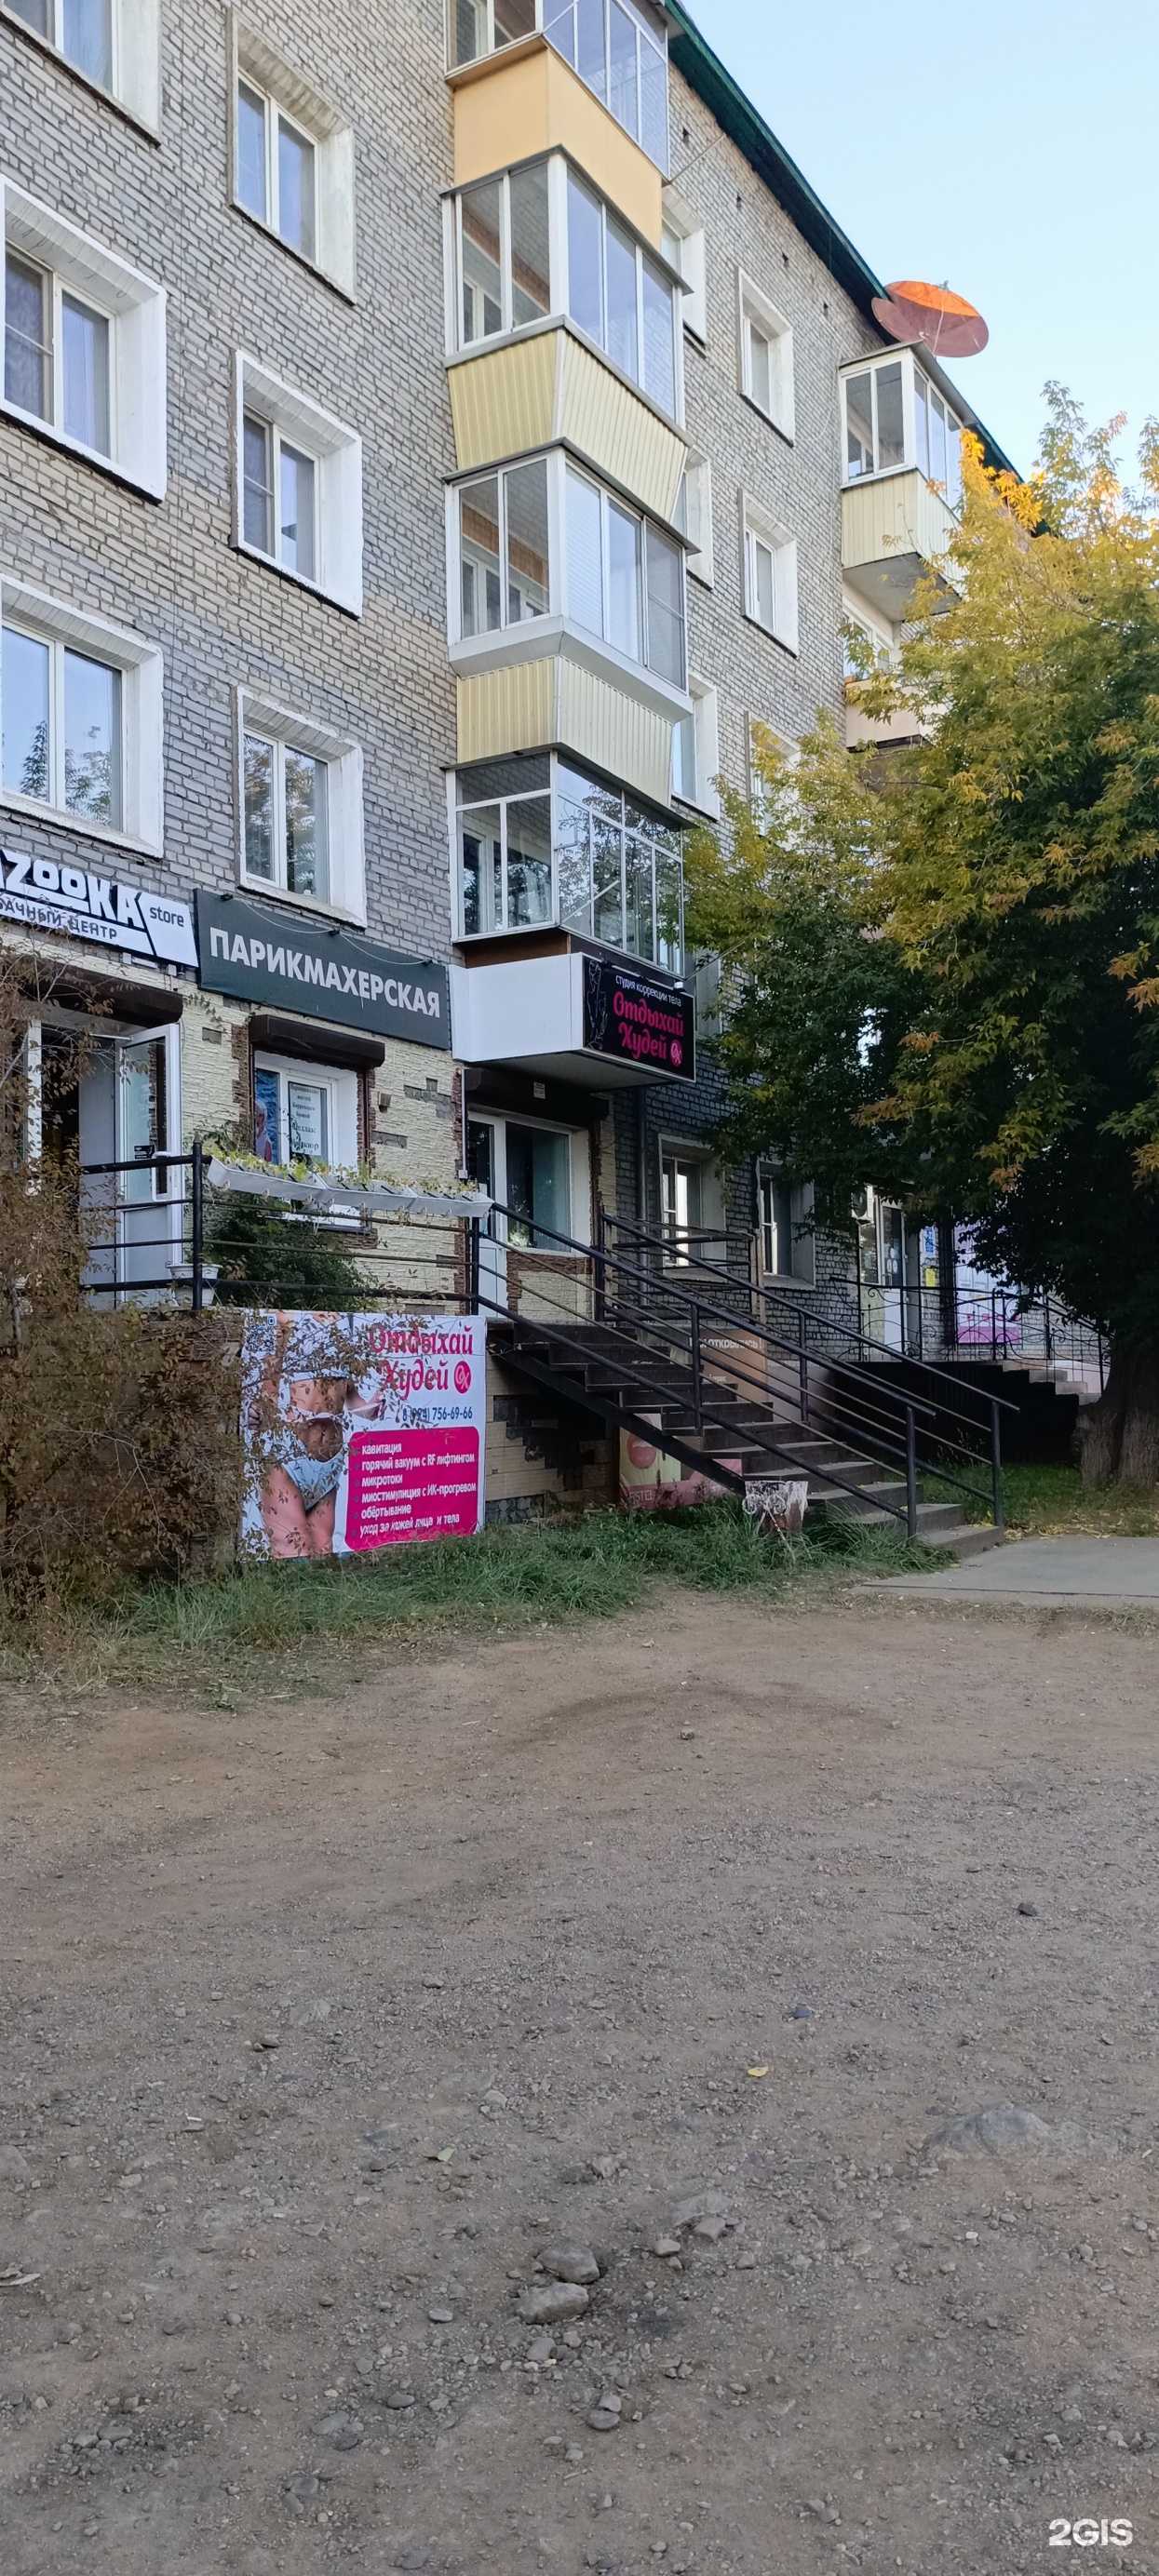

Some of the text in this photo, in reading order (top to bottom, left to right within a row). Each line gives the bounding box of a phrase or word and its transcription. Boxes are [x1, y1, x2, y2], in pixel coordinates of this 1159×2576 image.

[0, 848, 145, 930] ZOOKA
[68, 916, 117, 940] ЦЕНТР
[149, 906, 184, 927] store
[209, 926, 440, 1018] ПАРИКМАХЕРСКАЯ
[613, 990, 684, 1038] Отдыхай
[618, 1021, 668, 1060] Худей
[369, 1322, 473, 1355] Отдыхай
[381, 1358, 449, 1401] Худей
[431, 1406, 473, 1421] 756-69-66
[361, 1442, 402, 1456] кавитация
[361, 1456, 394, 1473] горячий
[395, 1456, 421, 1470] вакуум
[421, 1456, 426, 1467] с
[437, 1452, 475, 1468] лифтингом
[361, 1474, 403, 1488] микротоки
[422, 1487, 427, 1497] с
[427, 1482, 477, 1497] ИК-прогревом
[359, 1513, 460, 1538] уход за кожей лица и тела
